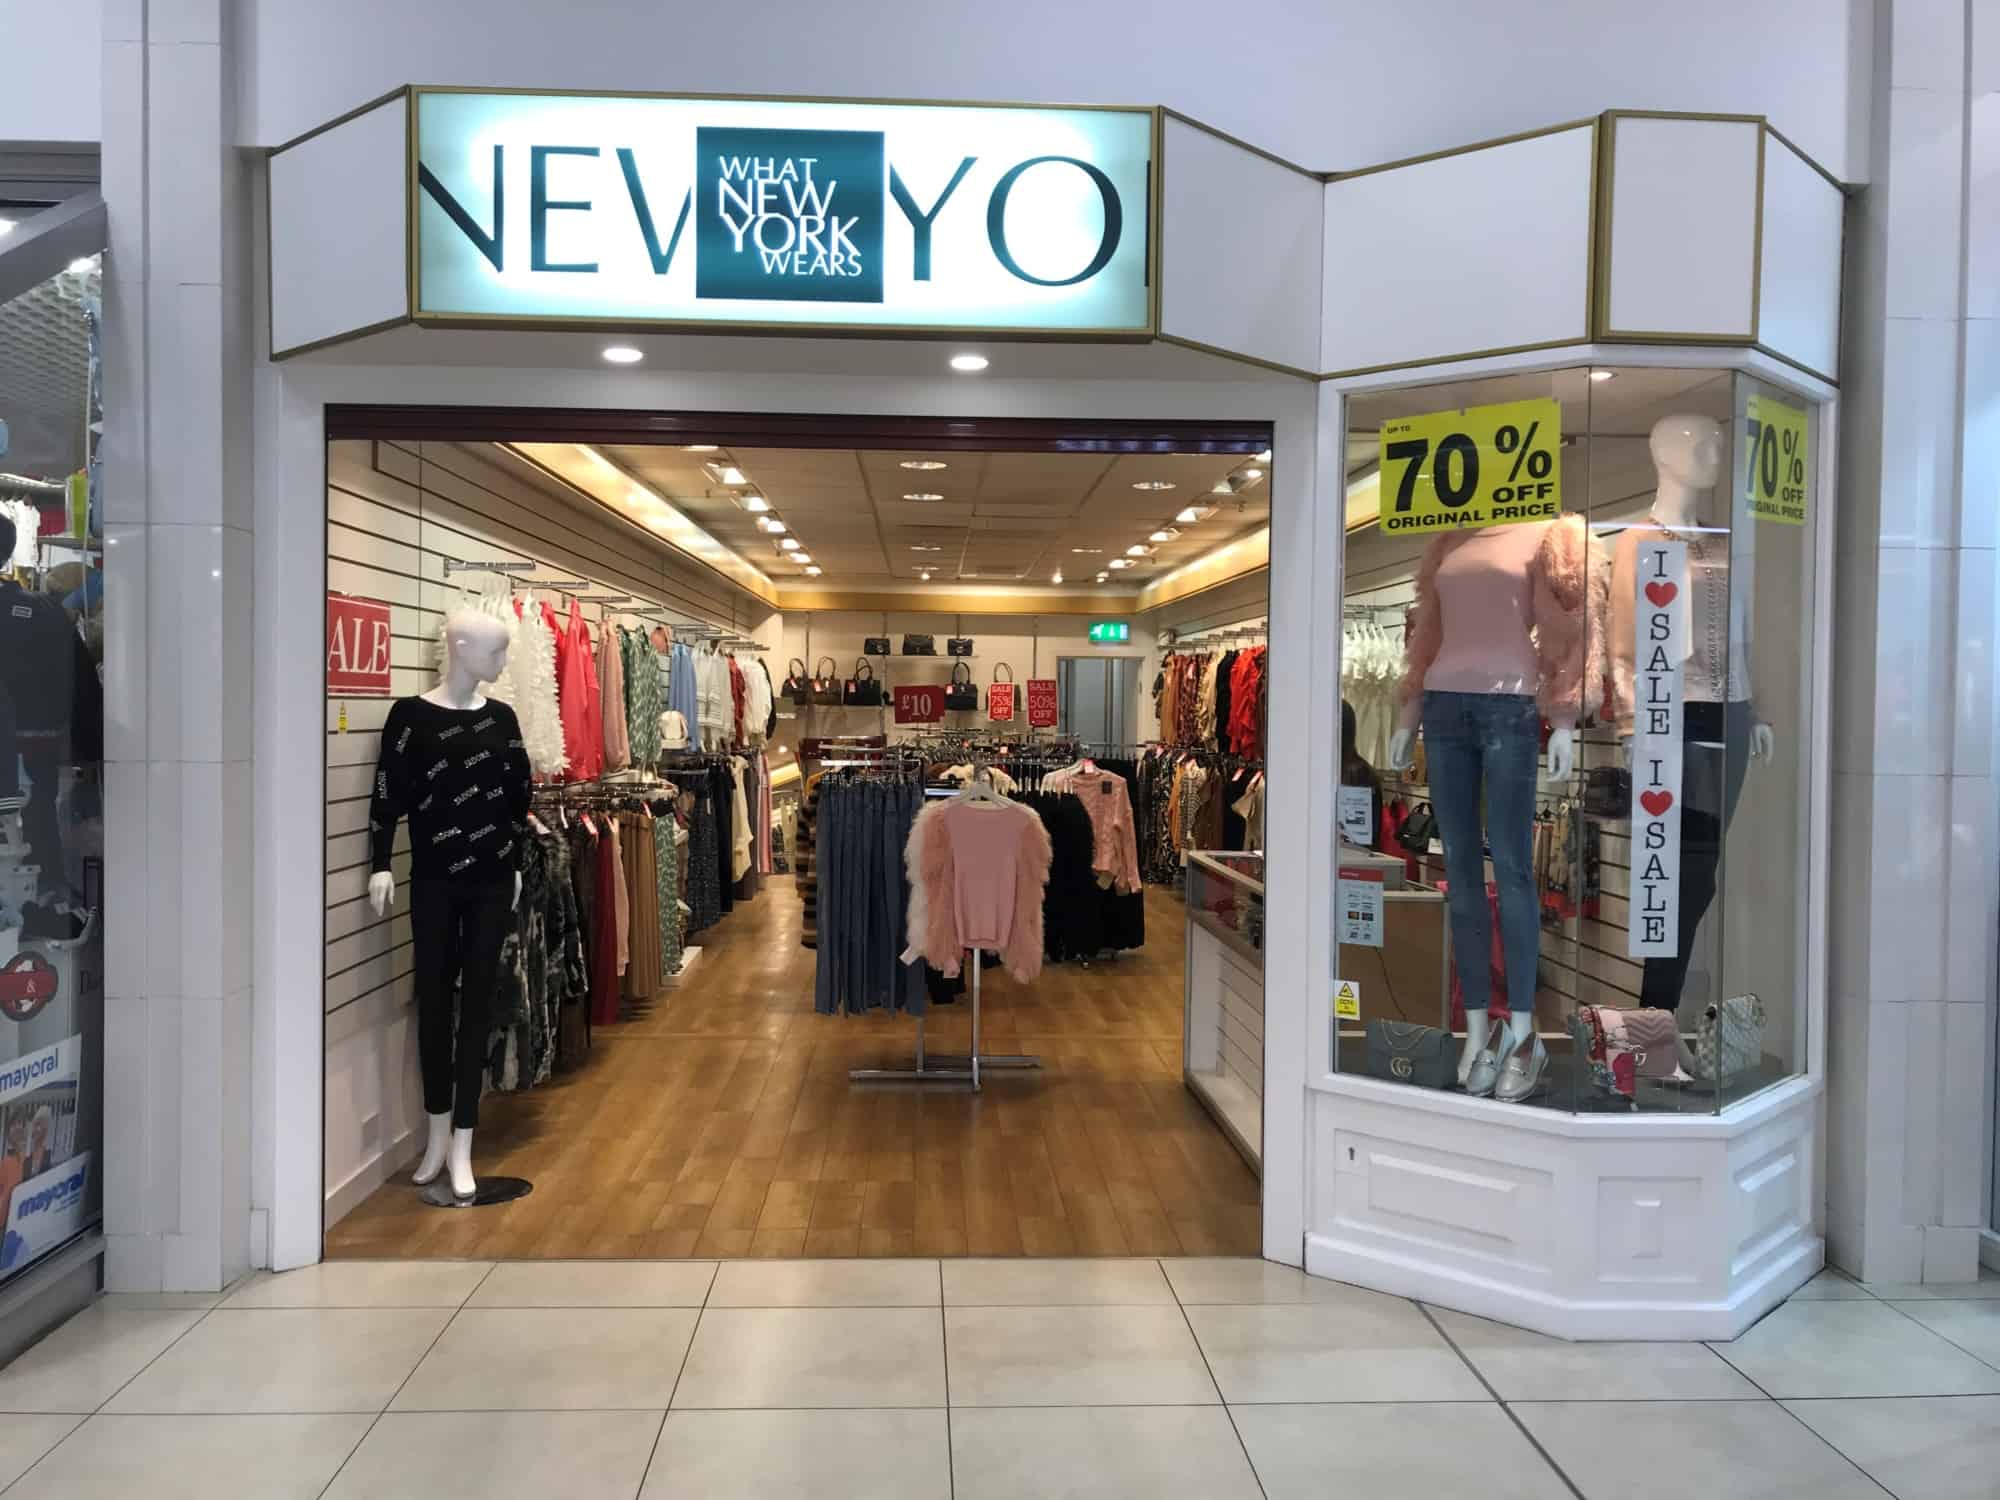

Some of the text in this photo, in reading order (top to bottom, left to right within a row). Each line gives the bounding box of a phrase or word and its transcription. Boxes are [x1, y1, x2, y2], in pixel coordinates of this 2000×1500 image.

[719, 155, 818, 182] WHAT
[719, 178, 837, 219] NEW
[722, 214, 860, 258] YORK
[760, 250, 863, 278] WEARS
[1492, 482, 1555, 504] OFF
[1782, 487, 1804, 504] OFF
[1387, 502, 1556, 530] ORIGINAL PRICE
[1645, 612, 1675, 735] SALE
[901, 693, 932, 717] £10
[993, 706, 1009, 714] OFF
[1030, 695, 1056, 709] 50%
[1033, 710, 1053, 718] OFF
[1640, 821, 1669, 944] SALE
[0, 1048, 59, 1092] mayoral
[17, 1166, 86, 1220] mayoral
